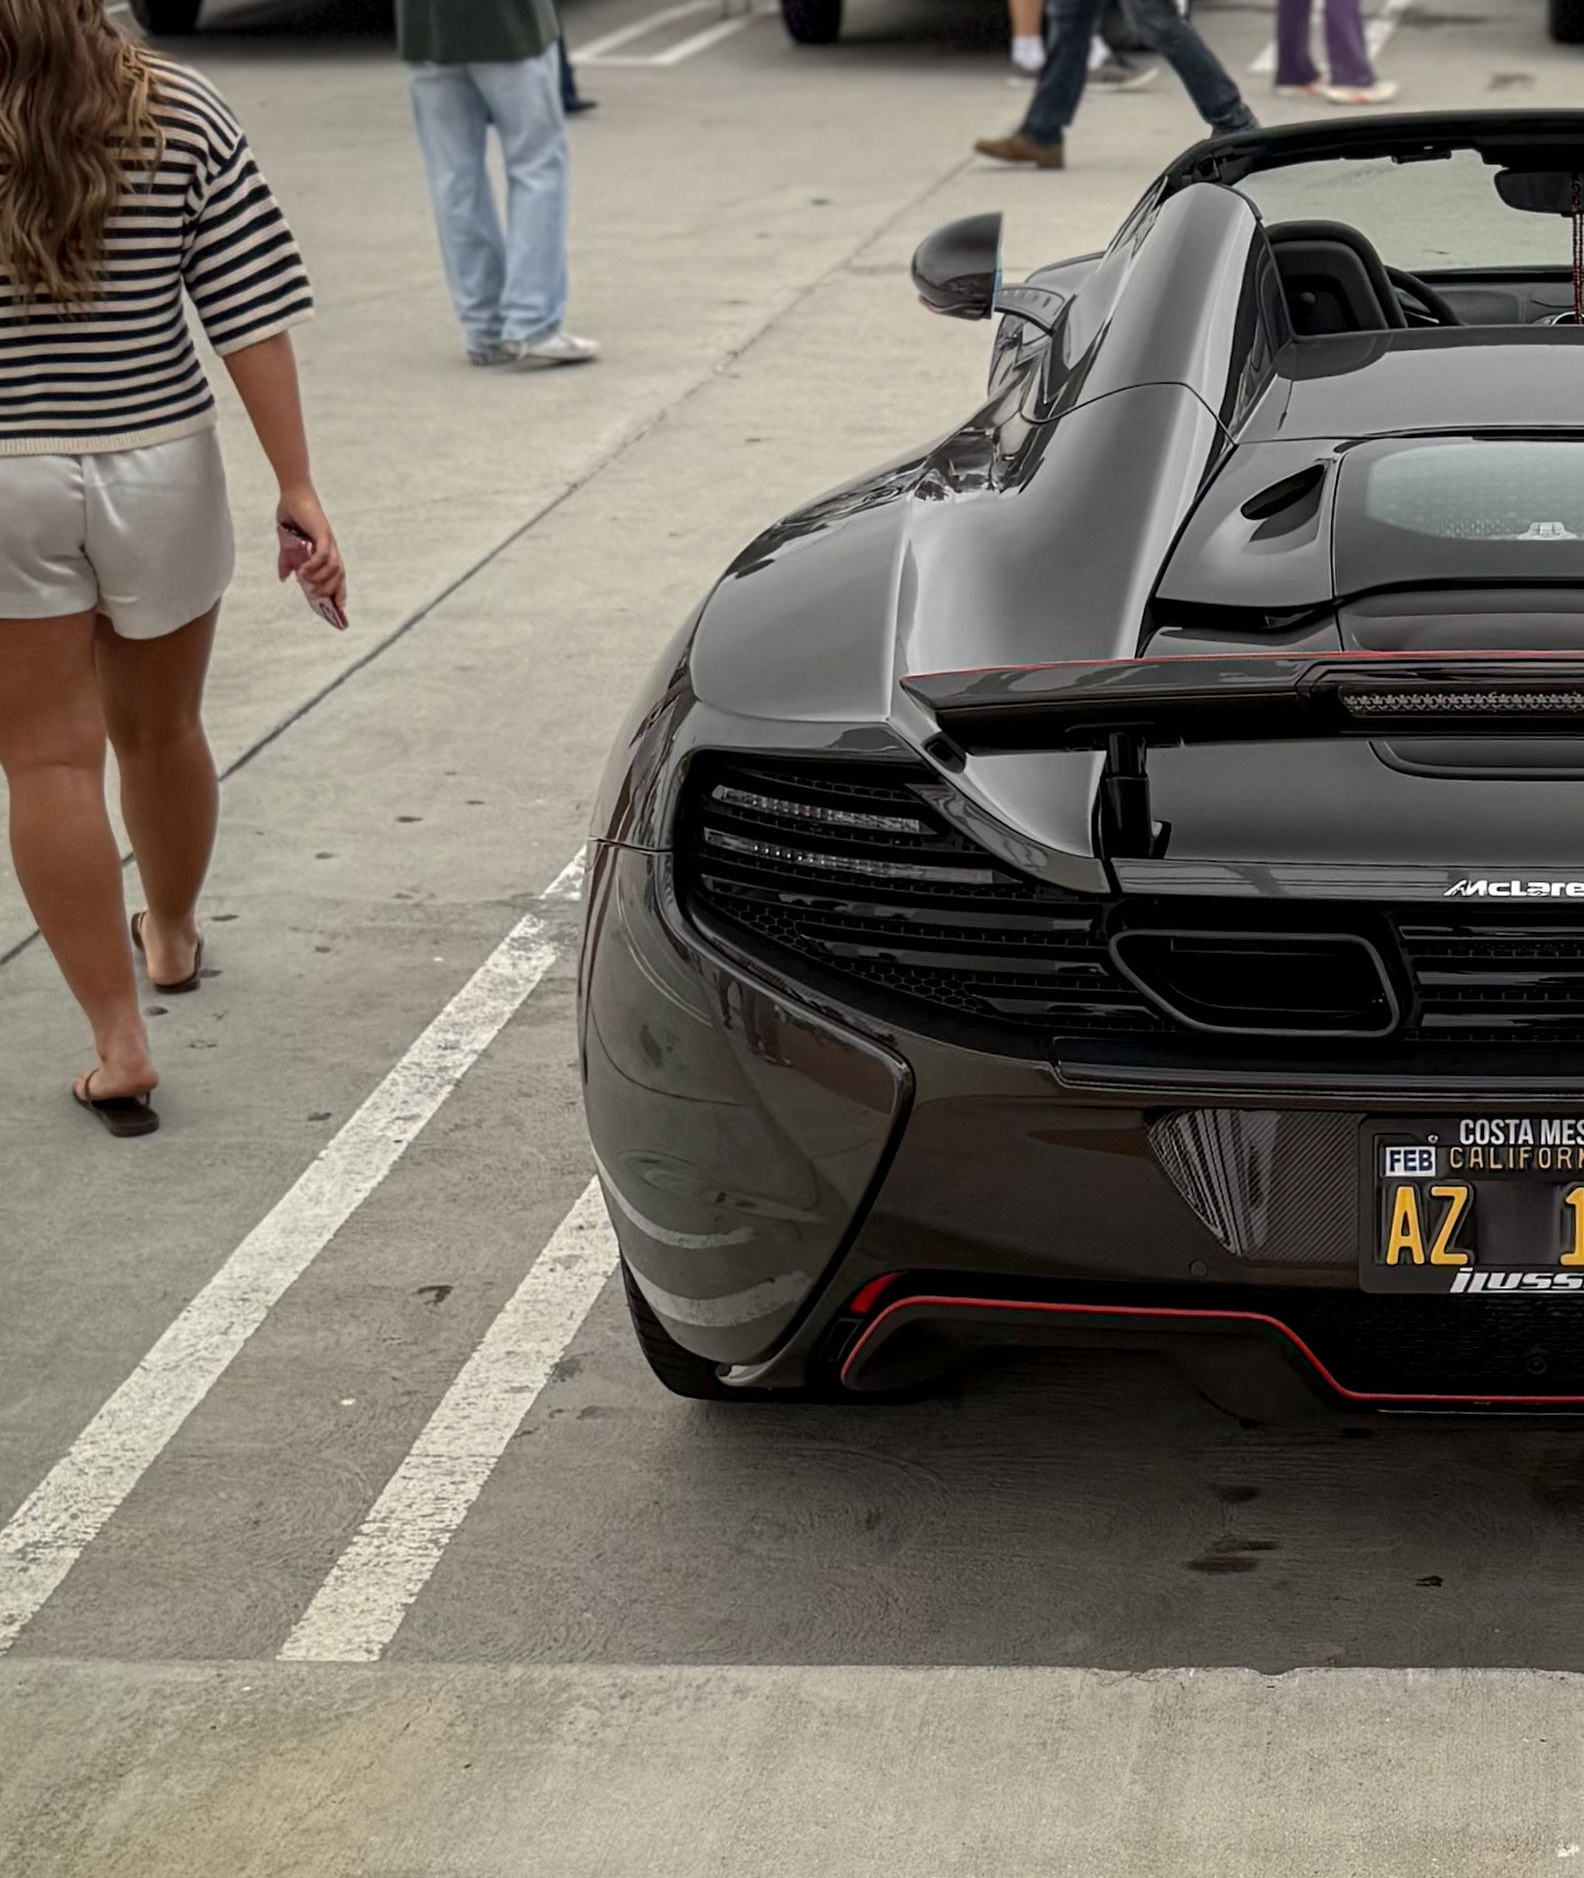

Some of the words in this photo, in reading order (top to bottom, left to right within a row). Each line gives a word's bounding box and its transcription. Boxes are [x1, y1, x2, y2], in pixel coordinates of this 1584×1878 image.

[1459, 1119, 1532, 1146] COSTA
[1389, 1149, 1433, 1172] FEB
[1386, 1186, 1468, 1265] AZ
